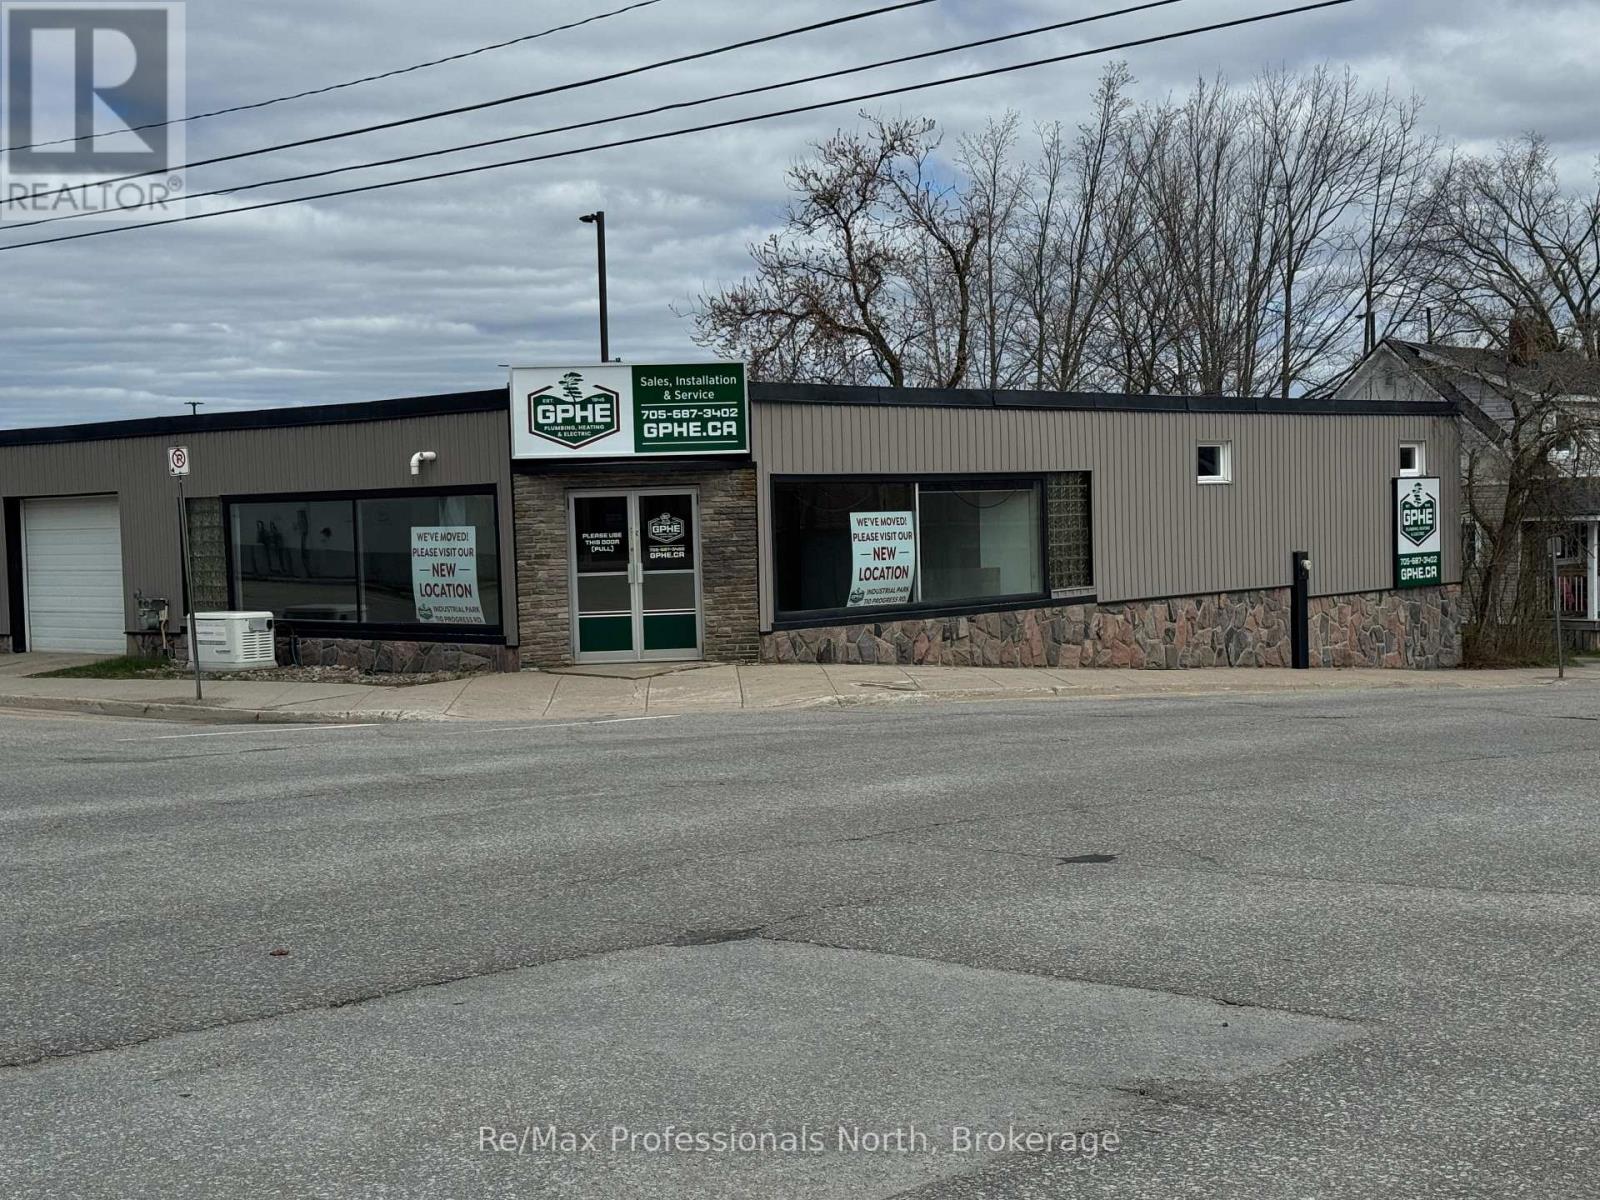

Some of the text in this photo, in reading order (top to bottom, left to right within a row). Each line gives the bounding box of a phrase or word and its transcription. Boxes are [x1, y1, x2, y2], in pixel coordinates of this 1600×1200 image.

[640, 374, 737, 388] Sales, Installation
[663, 389, 715, 401] & Service
[537, 403, 612, 424] GPHE
[640, 408, 739, 420] 705-687-3402
[643, 420, 738, 438] GPHE.CA
[880, 516, 907, 526] MOVED!
[1403, 508, 1433, 526] GPHE
[652, 524, 681, 533] GPHE
[416, 531, 469, 542] WE'VE MOVED!
[853, 531, 913, 542] PLEASE VISIT OUR
[412, 547, 474, 557] PLEASE VISIT OUR
[649, 551, 685, 559] GPHE.CA
[873, 546, 897, 561] NEW
[431, 563, 456, 578] NEW
[859, 565, 910, 582] LOCATION
[1401, 566, 1438, 580] GPHE.CA
[419, 583, 473, 598] LOCATION
